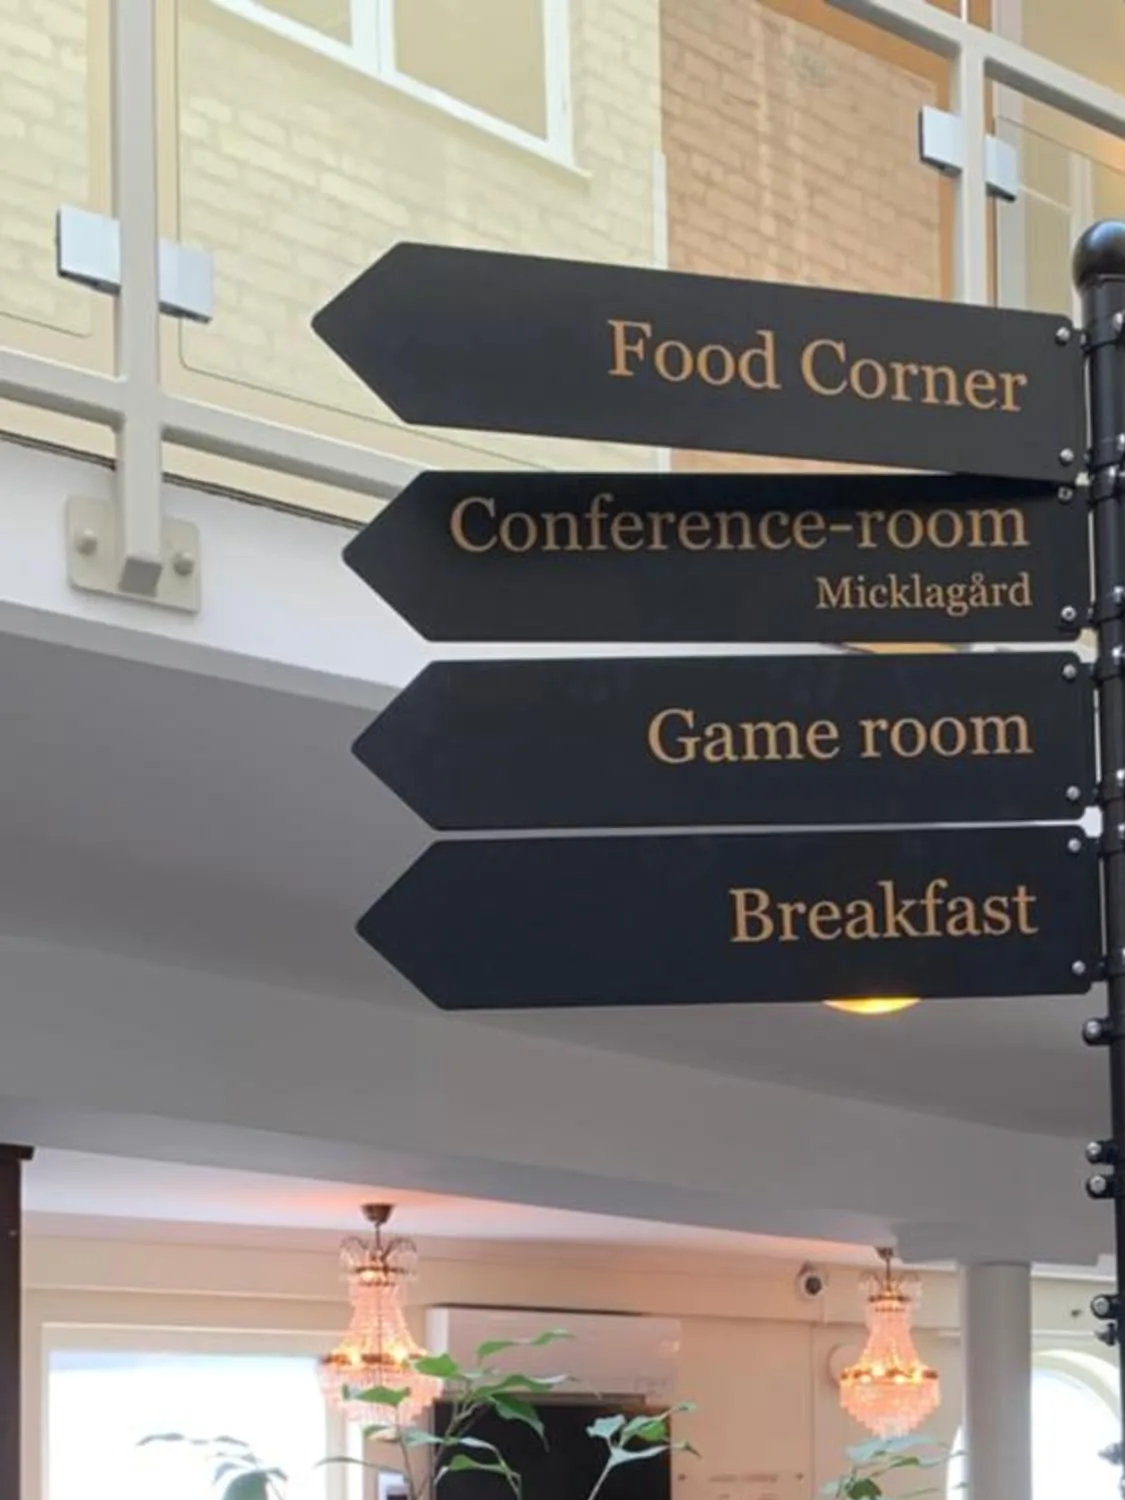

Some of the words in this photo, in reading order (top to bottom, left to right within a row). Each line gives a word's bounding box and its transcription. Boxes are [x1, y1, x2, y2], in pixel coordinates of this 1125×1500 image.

[608, 319, 780, 390] Food
[800, 340, 1027, 412] Corner
[449, 494, 1029, 552] Conference-room
[816, 573, 1032, 616] Micklagård
[646, 708, 839, 764] Game
[860, 713, 1034, 759] room
[729, 877, 1039, 944] Breakfast
